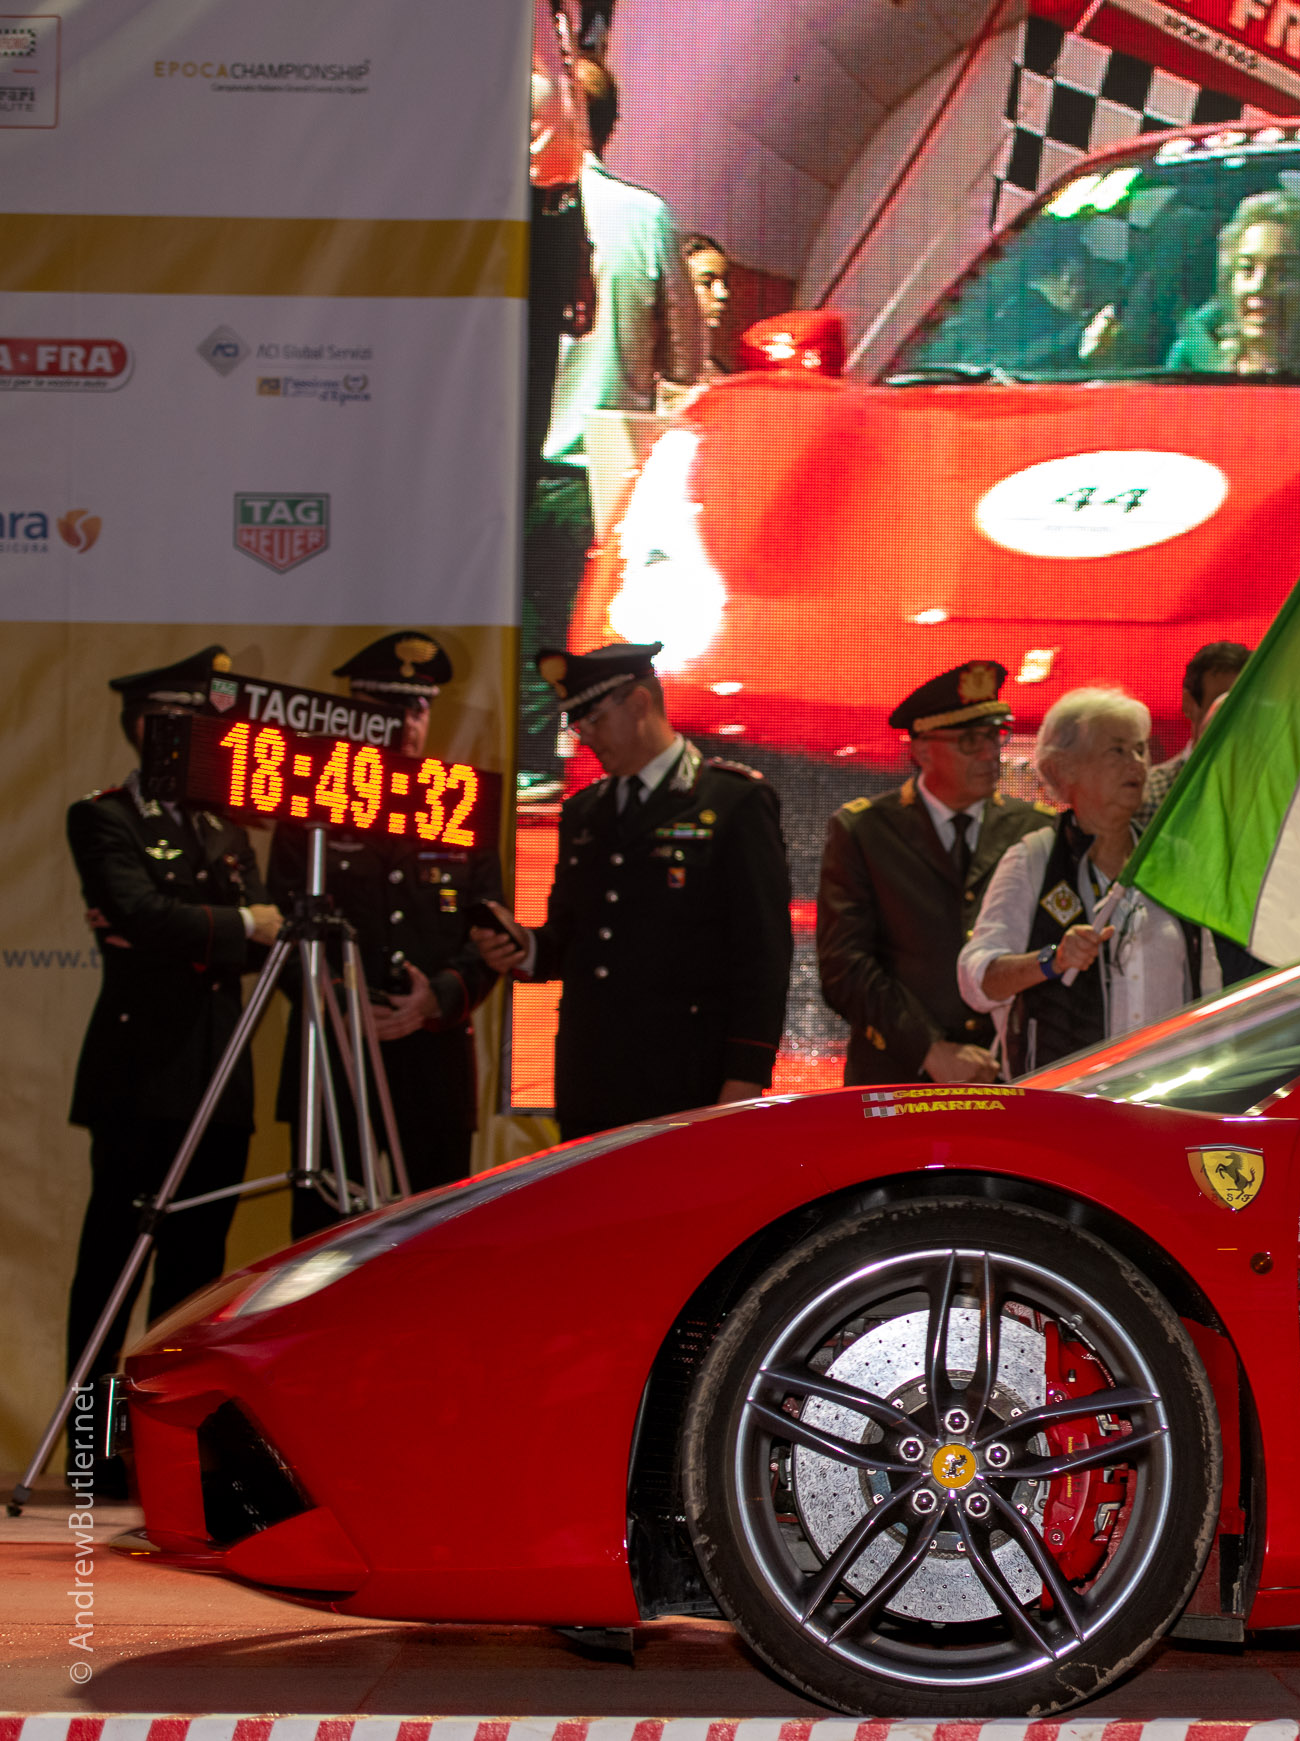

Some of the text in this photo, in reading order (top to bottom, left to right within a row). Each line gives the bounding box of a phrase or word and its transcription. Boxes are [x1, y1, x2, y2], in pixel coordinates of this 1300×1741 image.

[245, 500, 320, 524] TAG
[1053, 486, 1149, 513] 44
[0, 511, 49, 540] ra
[241, 530, 322, 564] HEUER
[219, 722, 479, 847] 18:49:32
